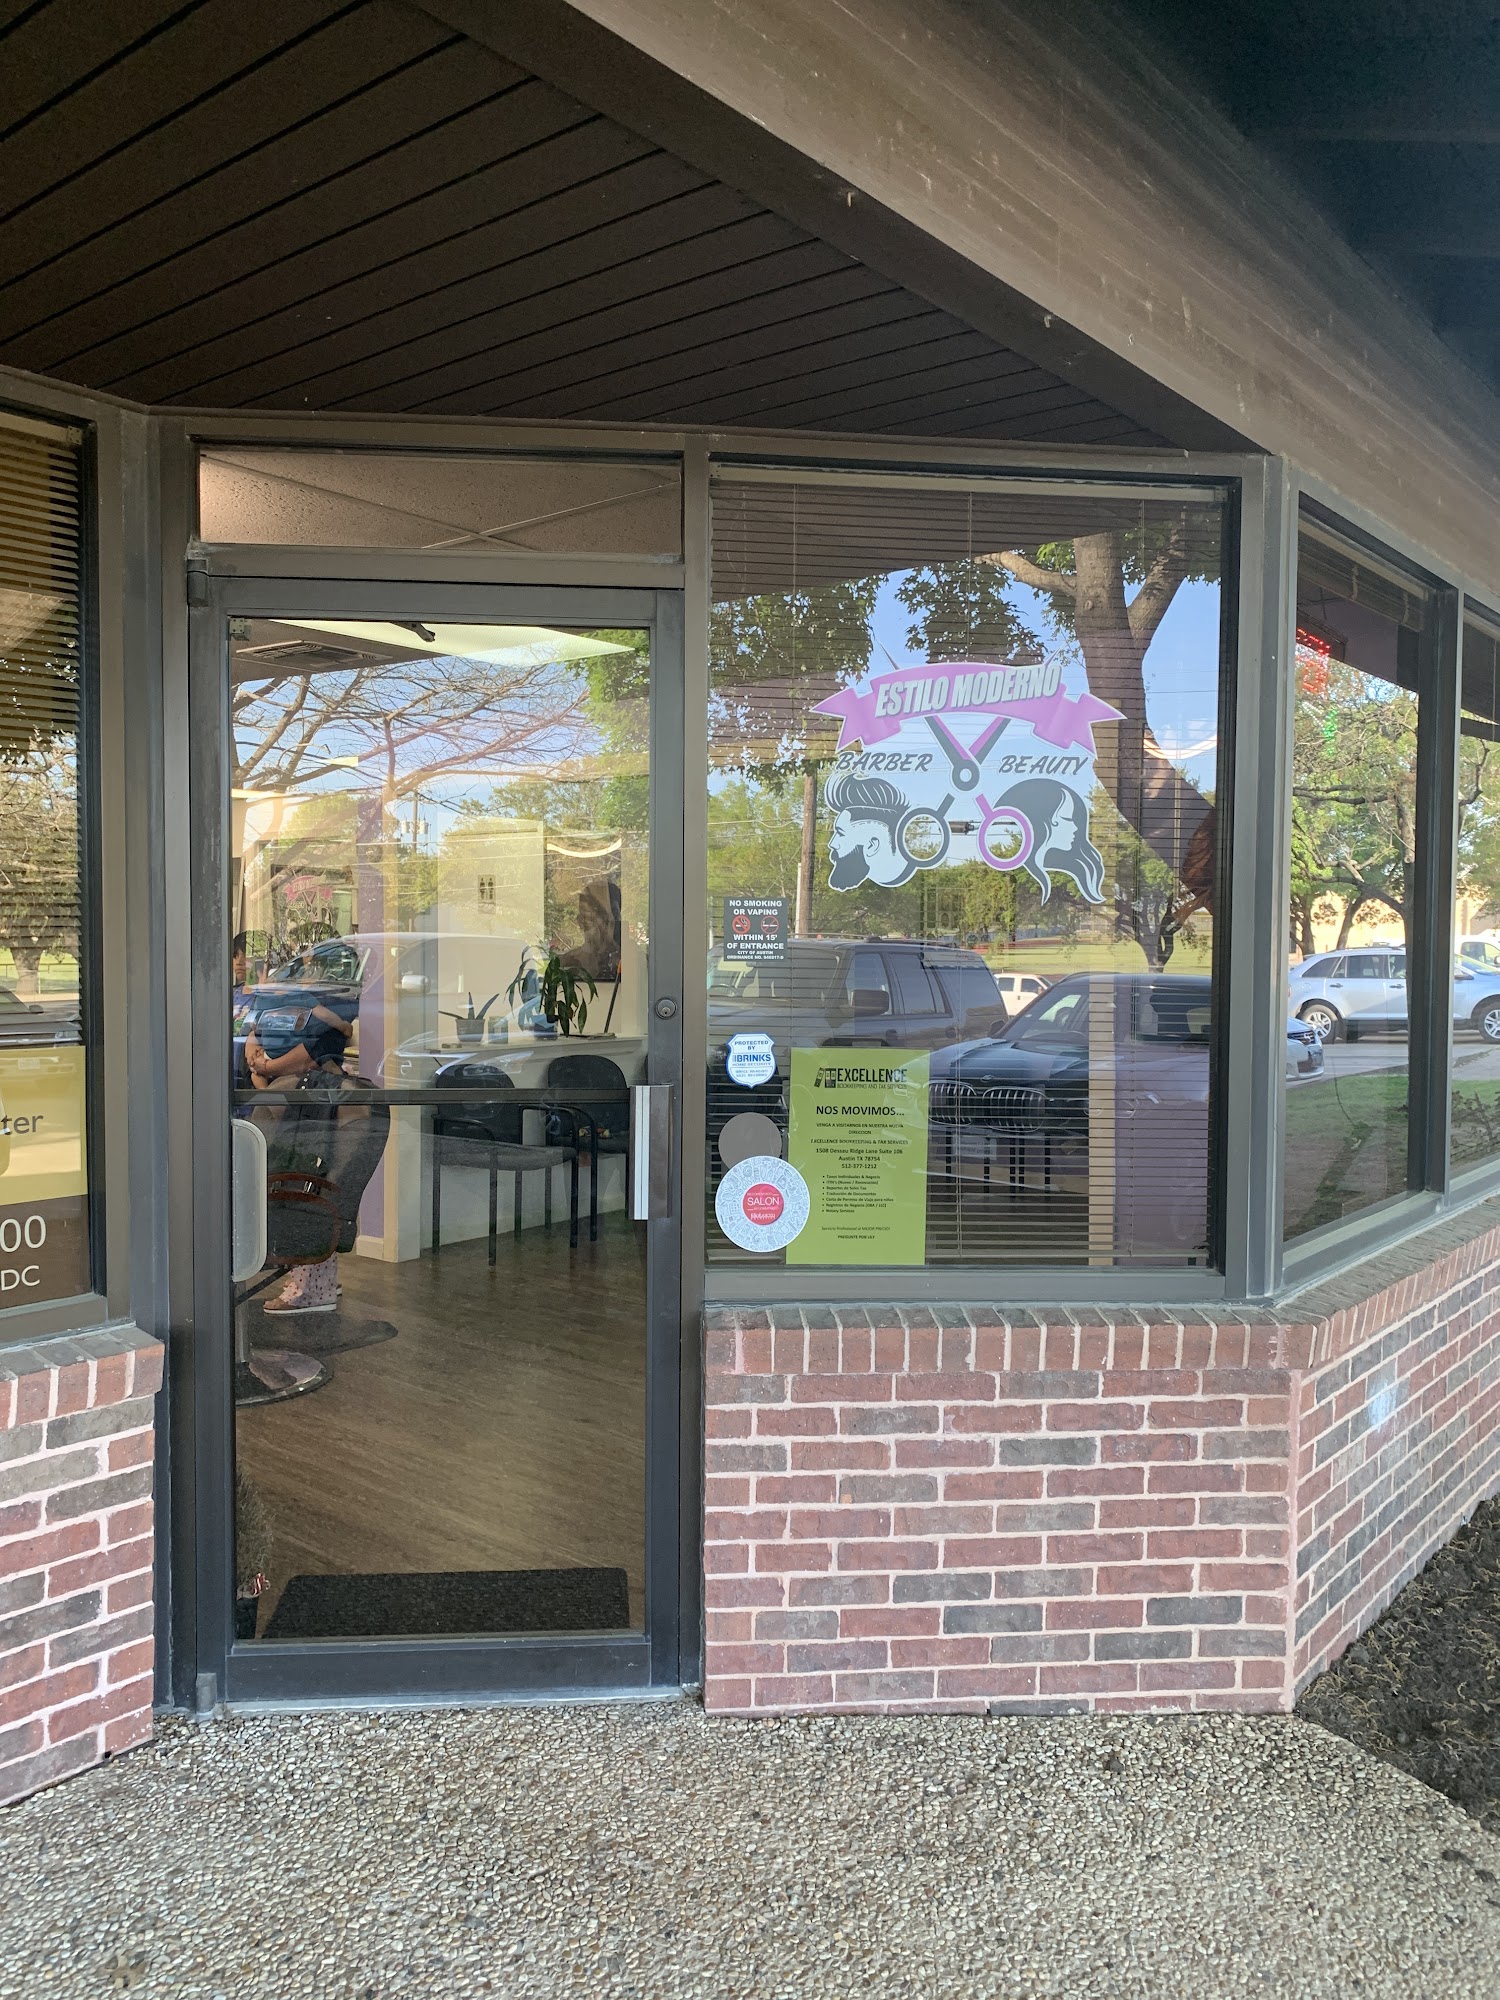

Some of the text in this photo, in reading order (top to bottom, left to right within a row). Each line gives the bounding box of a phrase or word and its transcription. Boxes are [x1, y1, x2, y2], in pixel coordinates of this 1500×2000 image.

[875, 664, 1062, 718] ESTILO MODERNO
[836, 751, 1088, 776] BARBER BEAUTY
[737, 1054, 771, 1062] BRINKS
[837, 1068, 907, 1082] EXCELLENCE
[816, 1106, 838, 1115] NOS
[747, 1197, 780, 1206] SALON
